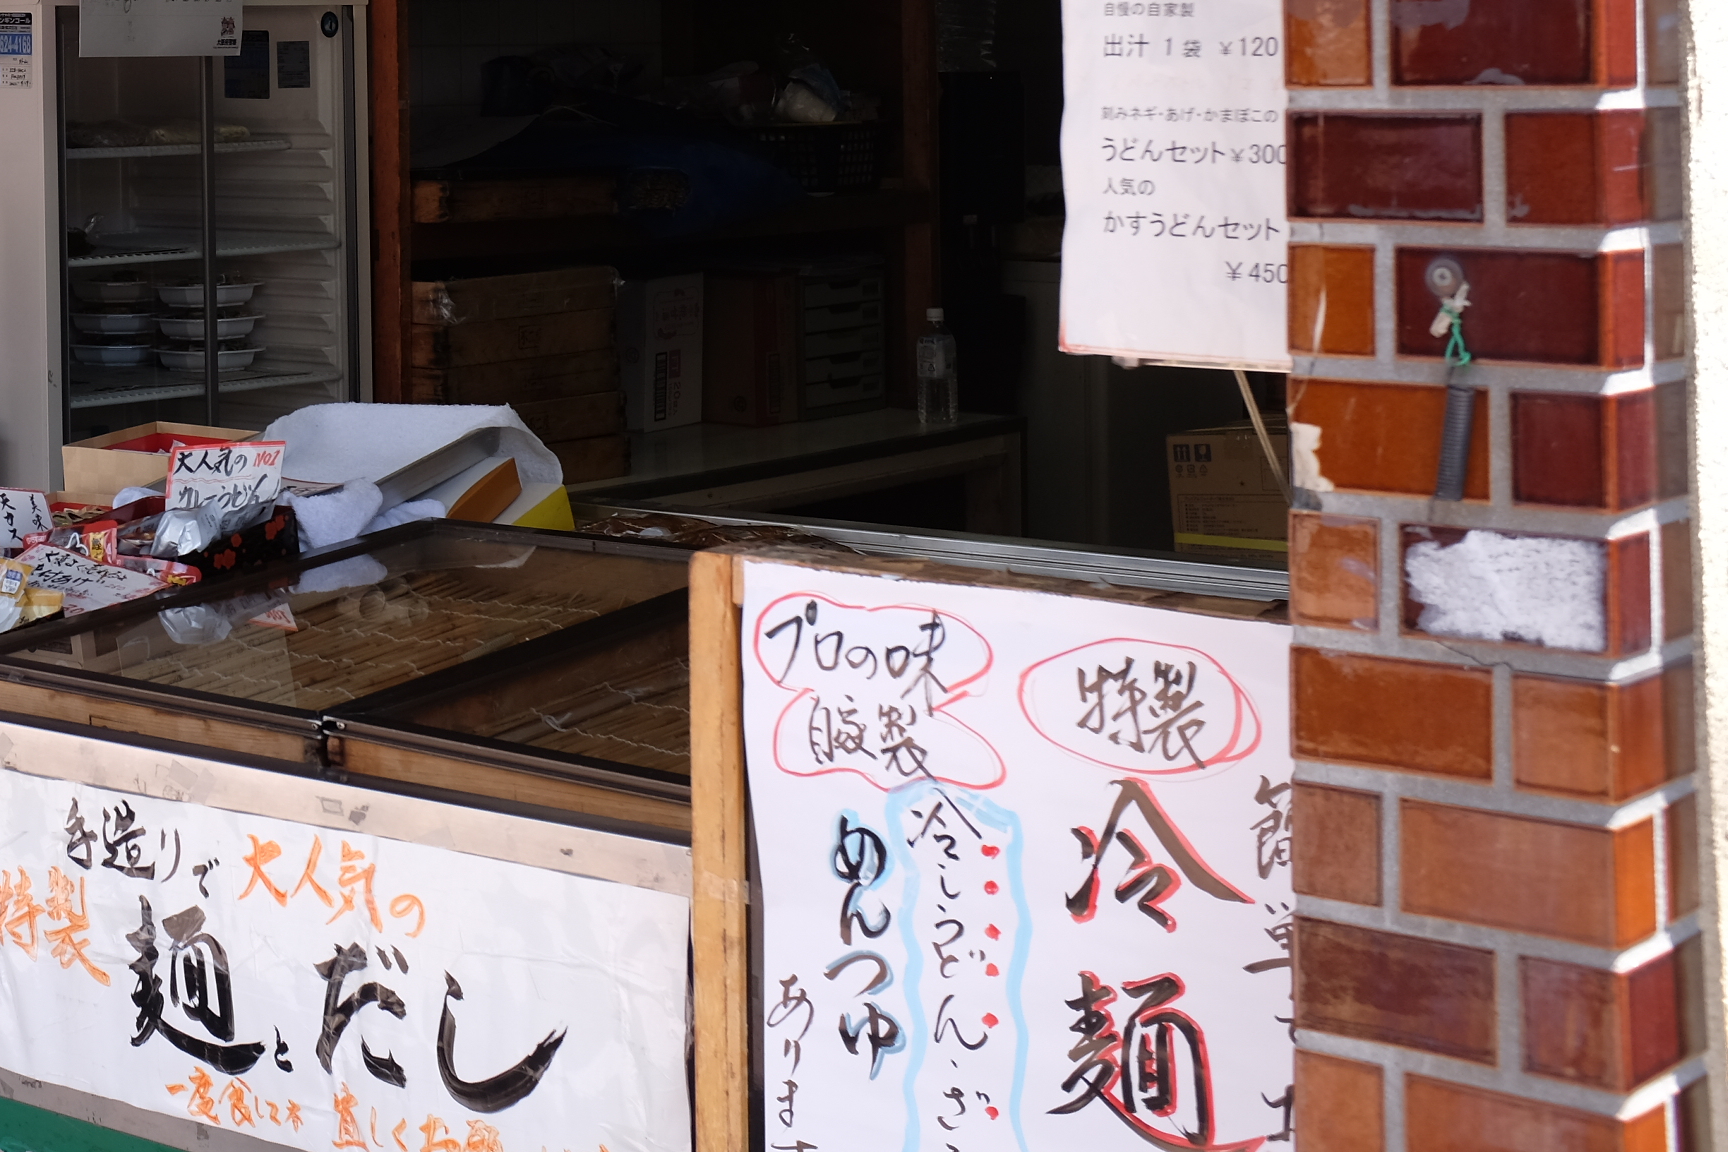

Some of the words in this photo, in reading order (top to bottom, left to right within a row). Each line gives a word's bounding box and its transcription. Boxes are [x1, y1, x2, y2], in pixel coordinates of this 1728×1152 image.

[1104, 1, 1195, 17] 自慢の自家製
[1103, 33, 1150, 57] 出汁
[1165, 37, 1172, 56] 1
[1182, 39, 1202, 58] 袋
[1101, 137, 1225, 164] うどんセット
[1102, 177, 1156, 196] 人気の
[1103, 211, 1280, 241] かすうどんセット
[174, 447, 247, 476] 大人気の
[29, 494, 48, 531] 美味
[764, 599, 951, 716] プロの味
[1076, 656, 1209, 770] 特製
[65, 798, 220, 899] 手造りで
[237, 832, 426, 939] 大人気の
[824, 811, 907, 1080] めんつゆ
[1046, 777, 1267, 1152] 冷麺
[130, 893, 569, 1114] 麺とだし
